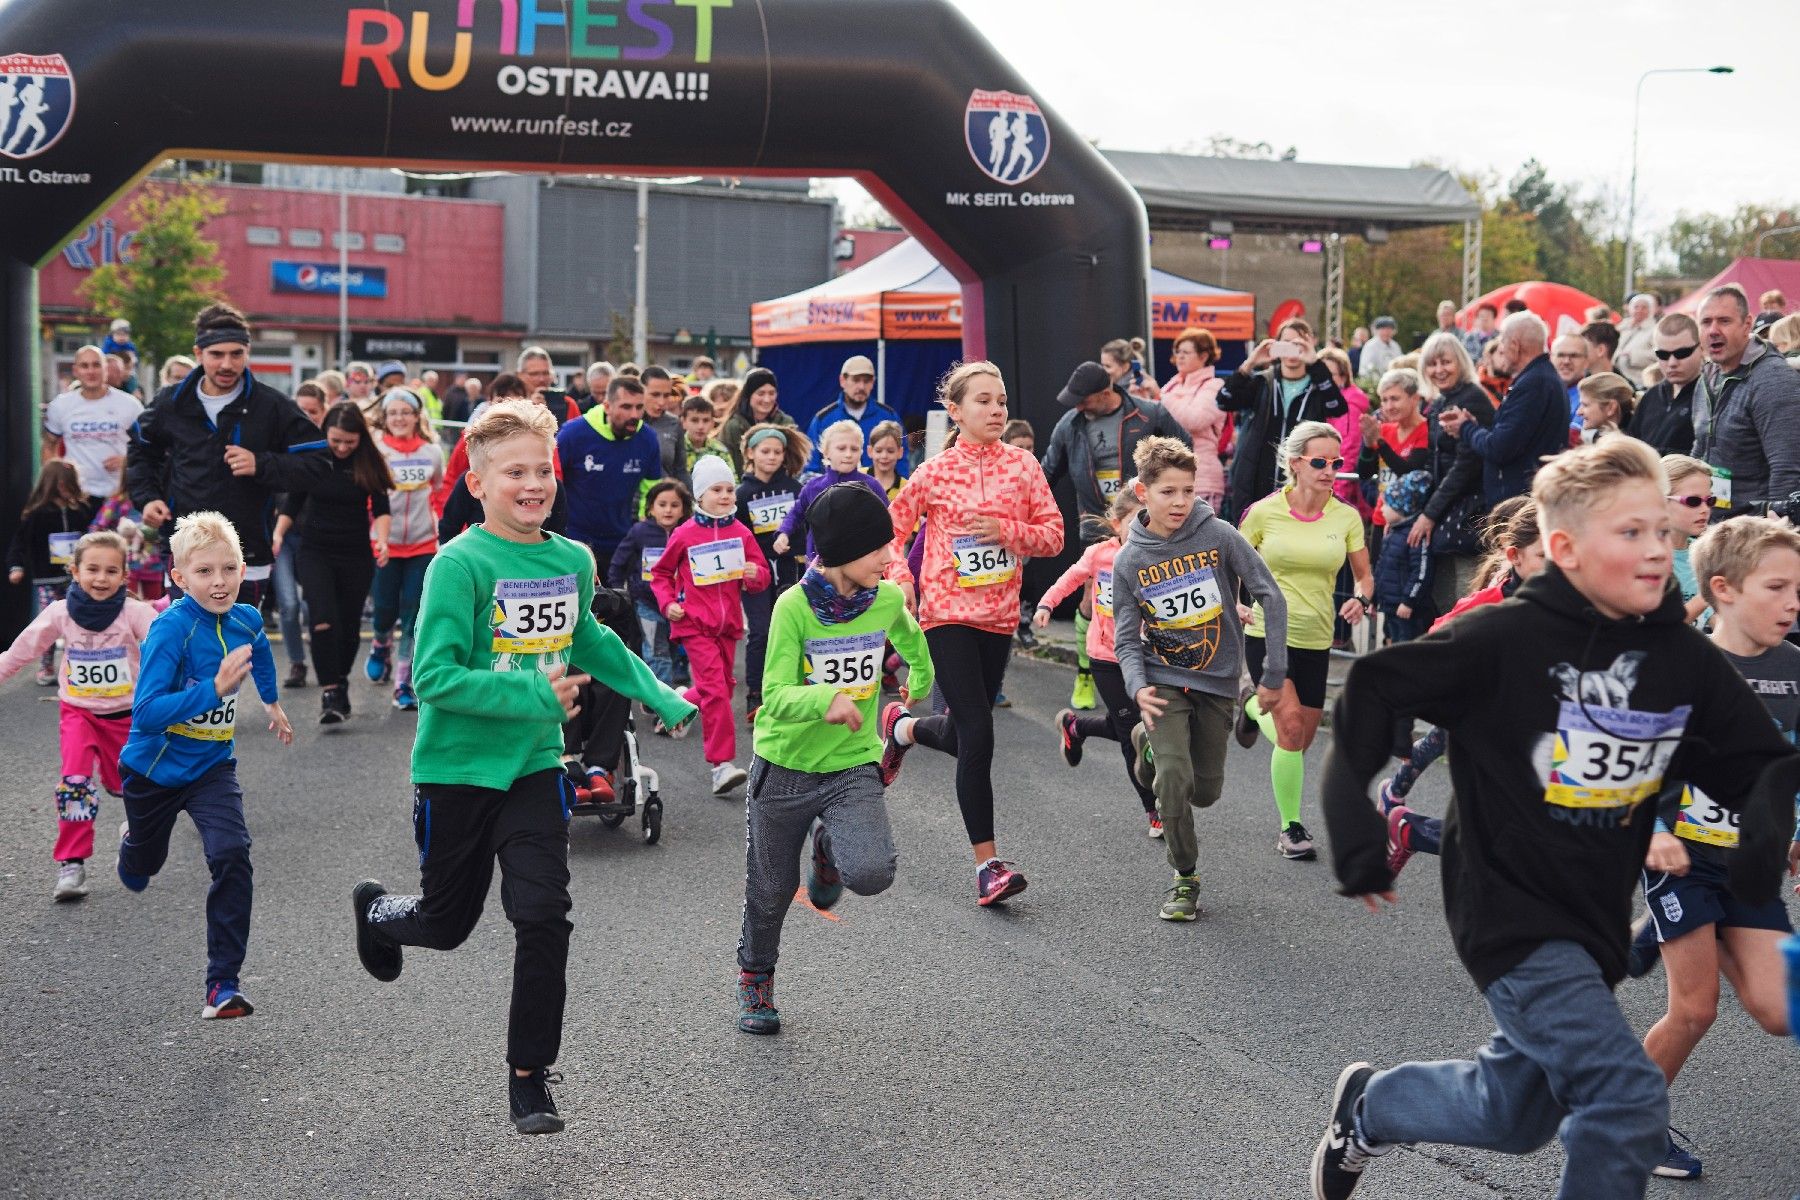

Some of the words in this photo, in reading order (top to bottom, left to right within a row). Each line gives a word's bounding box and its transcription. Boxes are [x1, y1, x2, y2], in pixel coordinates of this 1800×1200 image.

[496, 64, 709, 101] OSTRAVA!!!
[450, 114, 633, 138] www.runfest.cz
[28, 168, 91, 184] Ostrava
[946, 191, 971, 206] MK
[973, 192, 1017, 207] SEITL
[1020, 192, 1075, 206] Ostrava
[71, 421, 118, 432] CZECH
[400, 468, 426, 481] 358
[761, 505, 788, 522] 375
[713, 554, 725, 571] 1
[967, 547, 1009, 572] 364
[1137, 549, 1220, 588] COYOTES
[1162, 588, 1206, 617] 376
[516, 601, 566, 633] 355
[77, 664, 118, 684] 360
[824, 655, 874, 684] 356
[1583, 742, 1658, 782] 354
